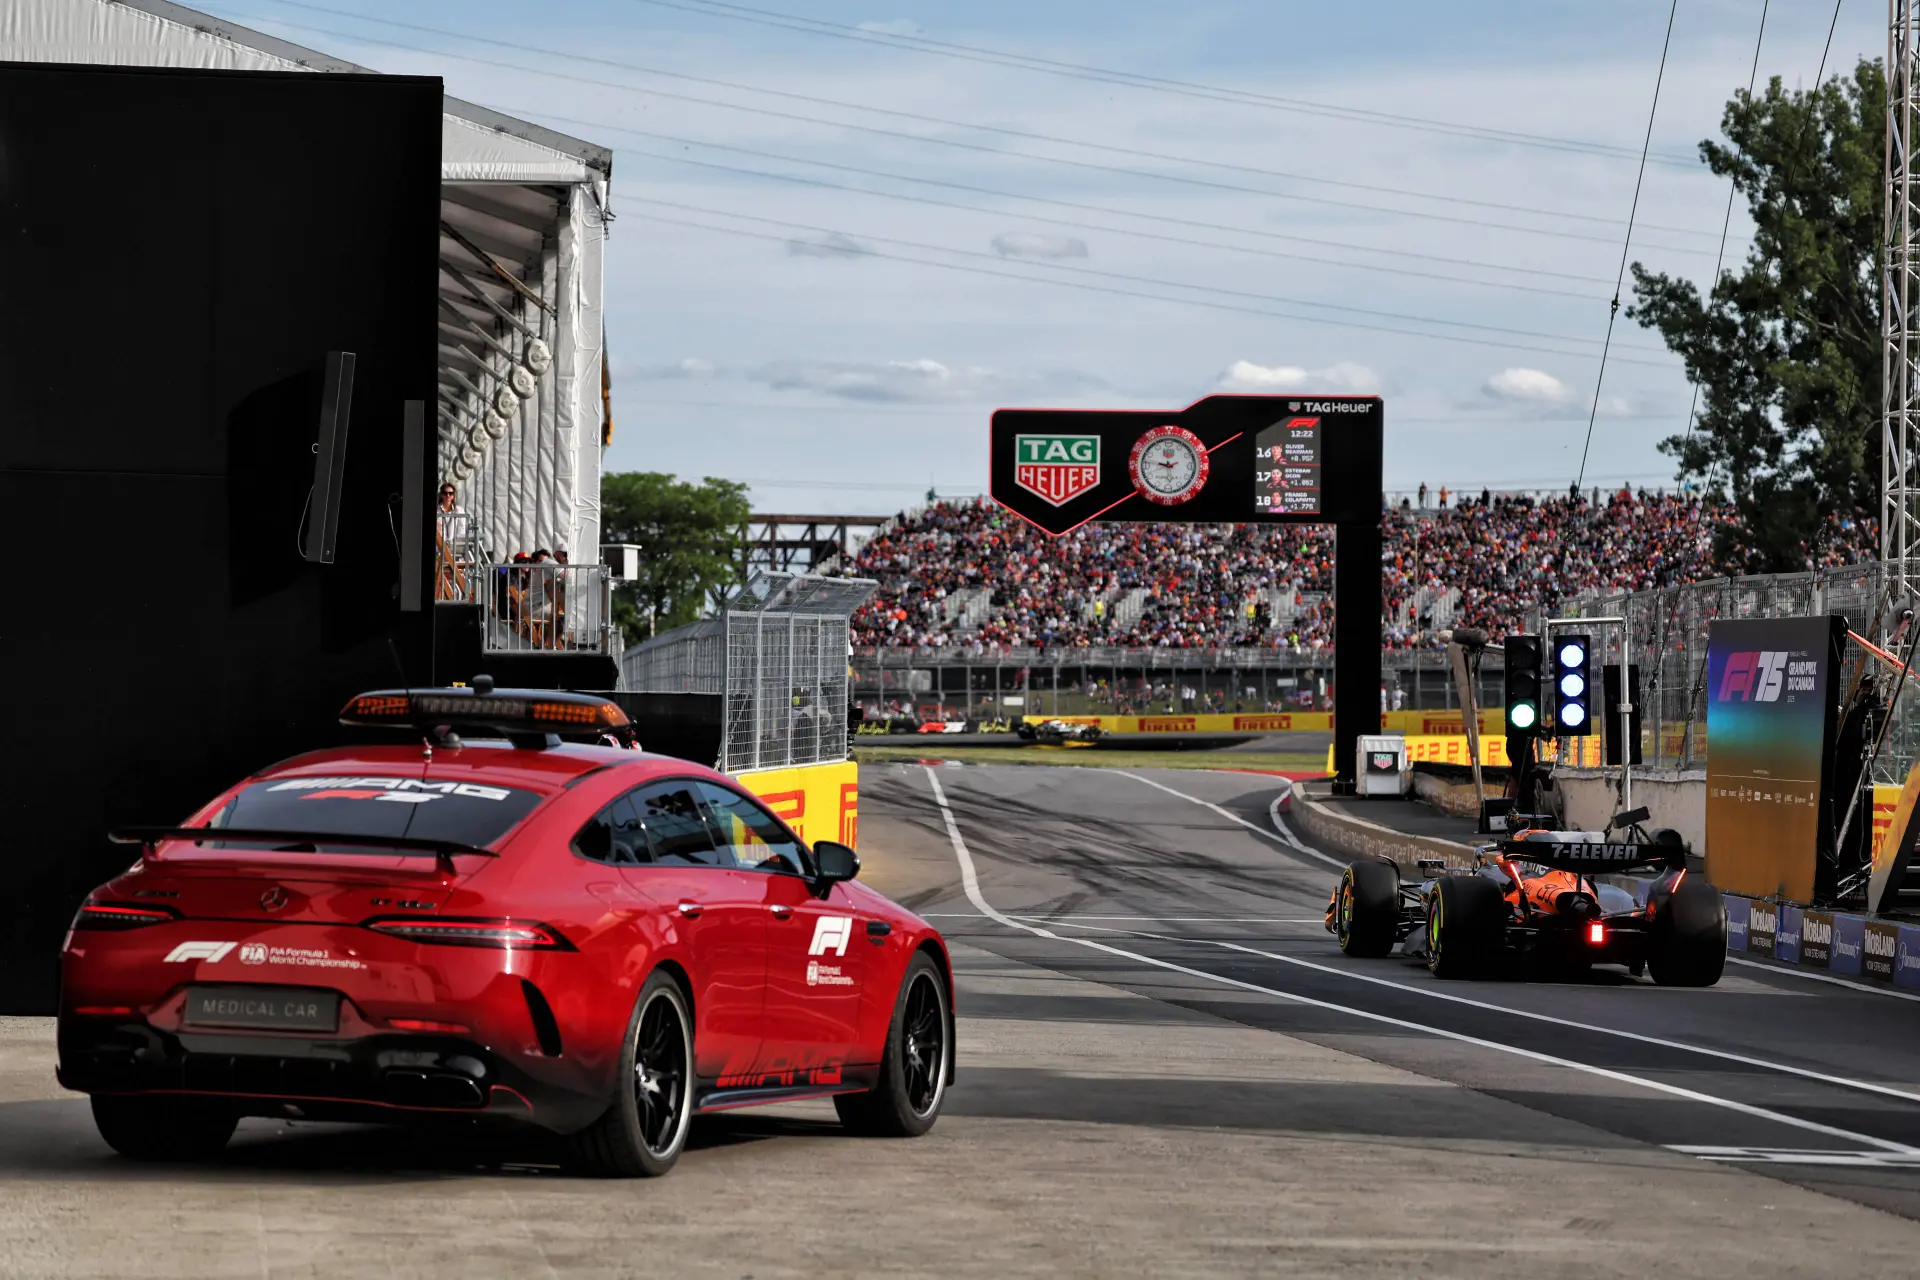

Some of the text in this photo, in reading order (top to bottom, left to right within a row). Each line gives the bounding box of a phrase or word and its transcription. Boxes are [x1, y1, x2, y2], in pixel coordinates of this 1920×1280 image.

[1290, 430, 1314, 438] 12:22
[1023, 440, 1093, 461] TAG
[1257, 447, 1271, 458] 16
[1021, 467, 1095, 500] HEUER
[1256, 471, 1271, 482] 17
[1256, 495, 1271, 506] 18
[1138, 717, 1196, 732] PIRELLI
[1234, 715, 1291, 731] PIRELLI
[808, 915, 853, 956] F1
[163, 941, 239, 963] F1
[240, 946, 268, 961] FIA
[269, 947, 285, 955] FIA
[286, 947, 323, 958] Formula
[269, 956, 361, 969] World Championship
[203, 999, 318, 1018] MEDICAL CAR
